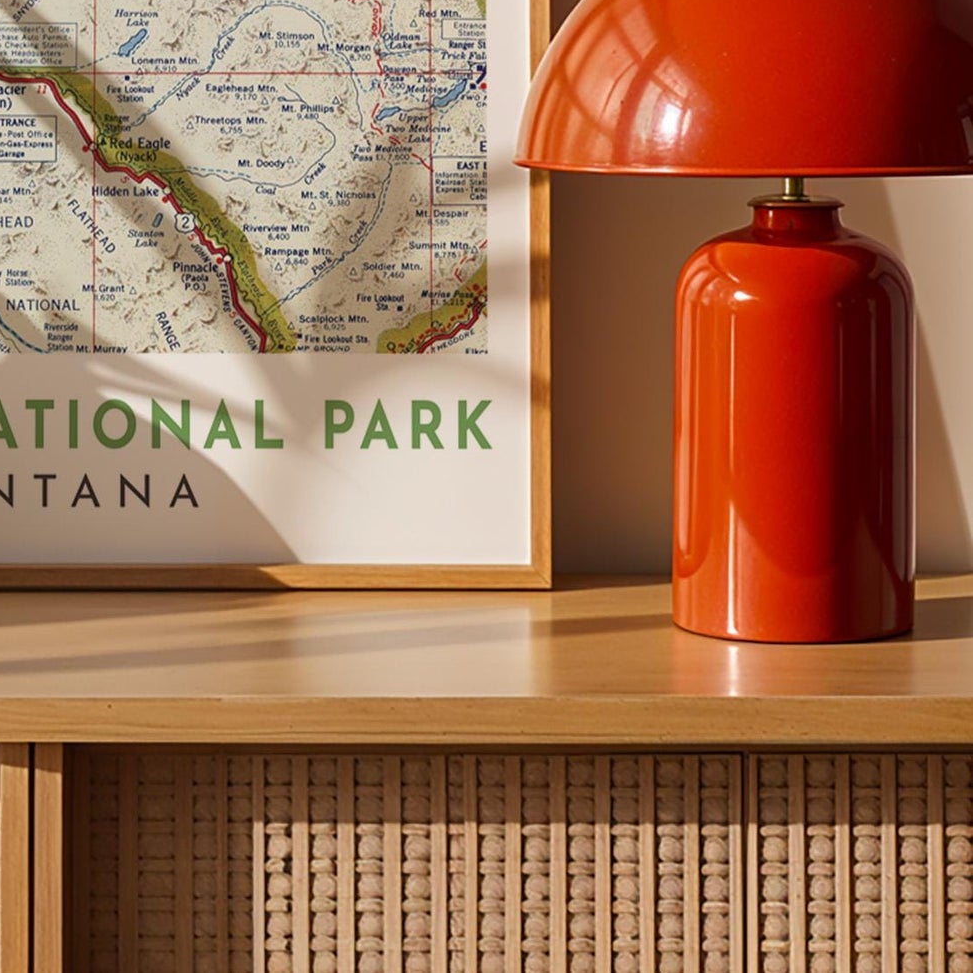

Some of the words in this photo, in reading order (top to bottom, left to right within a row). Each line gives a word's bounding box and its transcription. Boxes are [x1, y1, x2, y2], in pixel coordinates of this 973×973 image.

[115, 9, 158, 18] Harrison
[277, 32, 314, 40] Stimson
[300, 105, 334, 113] Phillips
[195, 116, 241, 125] Threetops
[110, 138, 133, 148] Red
[138, 138, 170, 150] Eagle
[115, 151, 156, 161] (Nyack)
[256, 160, 285, 168] Doody
[92, 187, 129, 196] Hidden
[134, 187, 159, 196] Lake
[67, 199, 115, 254] FLATHEAD
[265, 248, 309, 256] Rampage
[173, 263, 217, 272] Pinnacle
[6, 299, 80, 311] NATIONAL
[299, 315, 344, 323] Scalplock
[156, 312, 181, 351] RANGE
[324, 398, 493, 449] PARK
